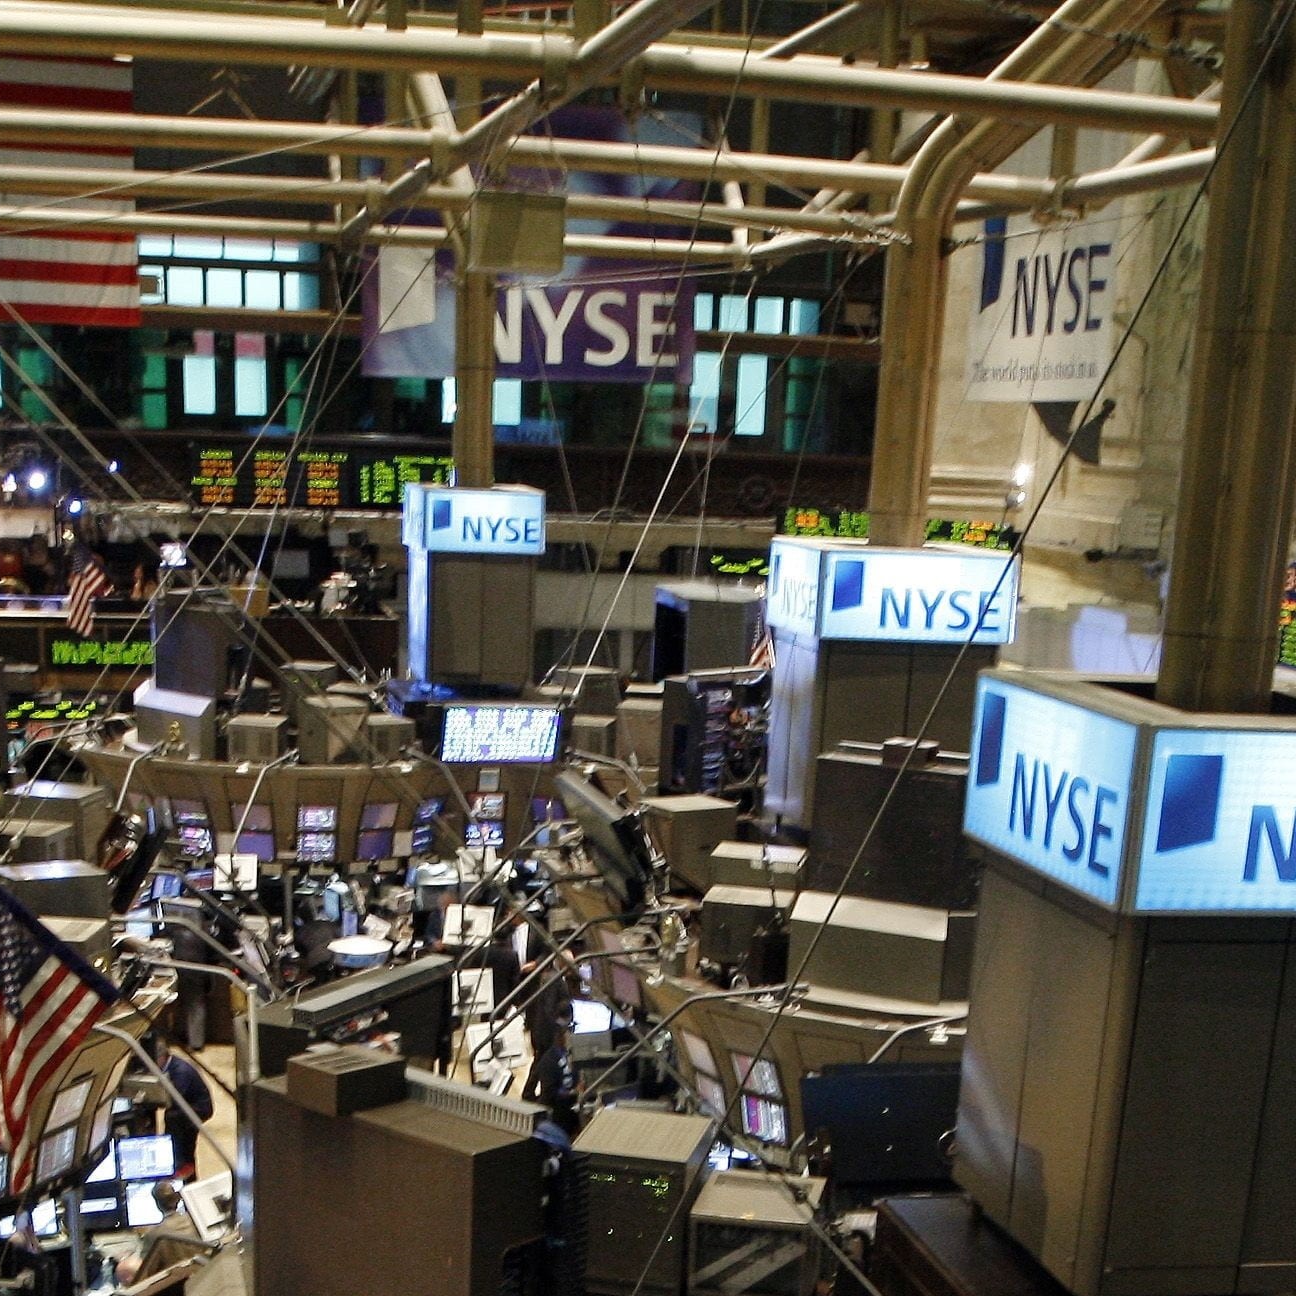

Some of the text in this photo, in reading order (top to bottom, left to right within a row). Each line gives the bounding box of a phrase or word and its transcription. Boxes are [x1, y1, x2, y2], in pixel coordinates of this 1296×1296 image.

[1010, 243, 1113, 339] NYSE
[462, 516, 541, 543] NYSE
[878, 587, 1003, 632] NYSE
[1009, 752, 1119, 878] NYSE
